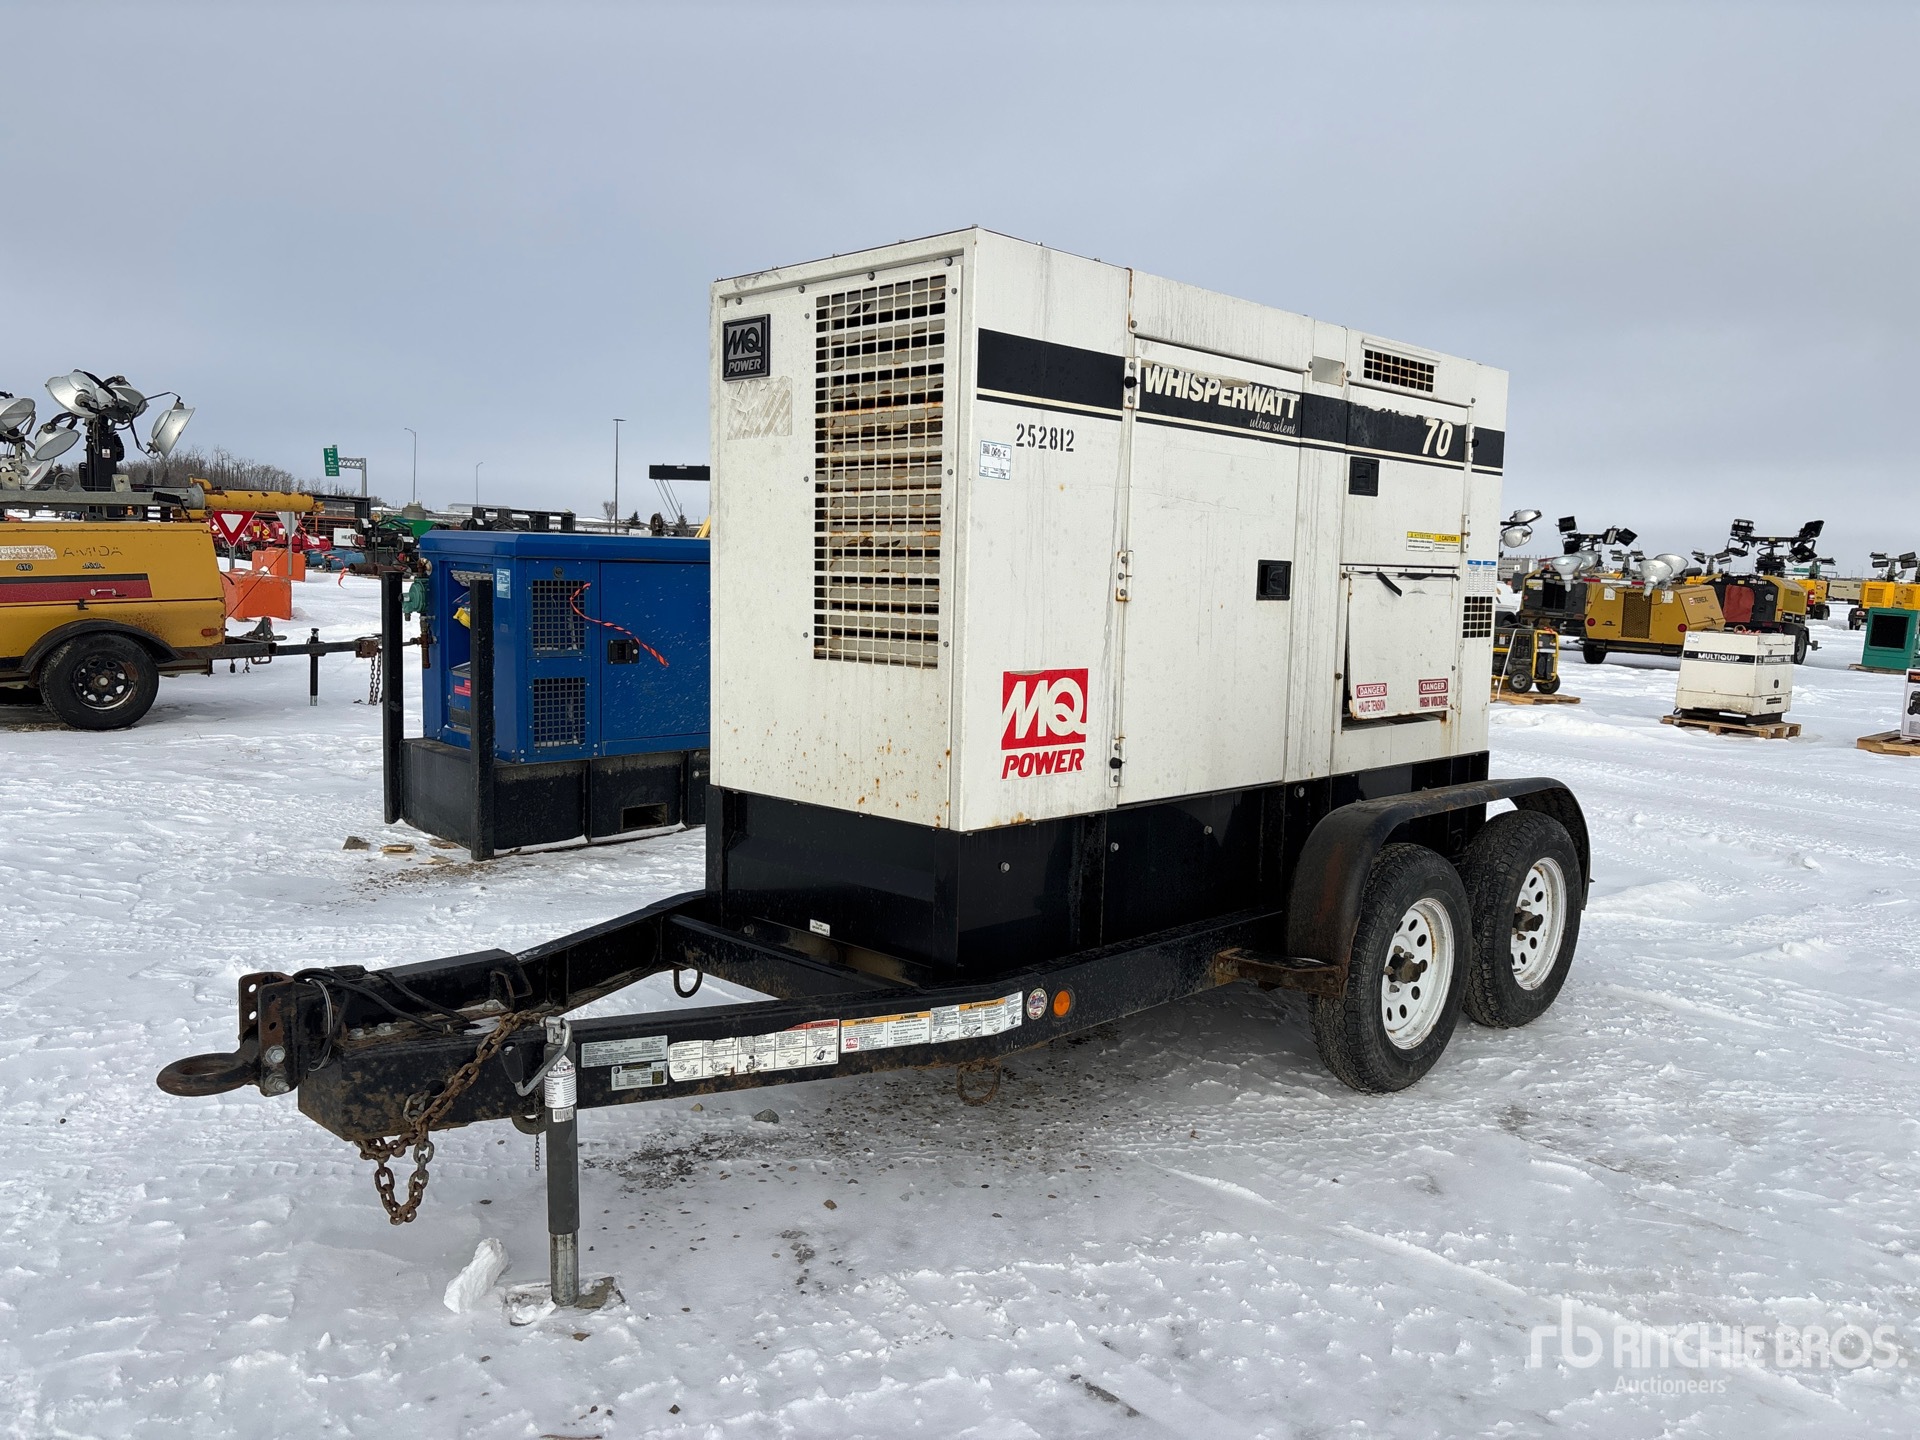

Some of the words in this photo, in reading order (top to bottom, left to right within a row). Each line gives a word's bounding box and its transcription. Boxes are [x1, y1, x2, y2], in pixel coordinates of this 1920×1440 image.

[727, 326, 762, 356] MQ
[728, 359, 762, 374] POWER
[1145, 364, 1300, 419] WHISPERWATT
[1249, 412, 1272, 430] ultra
[1272, 417, 1297, 435] silent
[1016, 423, 1075, 452] 252812
[1422, 418, 1453, 457] 70
[16, 562, 33, 571] 410
[1698, 652, 1740, 661] MULTIQUIP
[1360, 684, 1384, 695] DANGER
[1422, 682, 1445, 691] DANGER
[1001, 678, 1086, 739] MQ
[1420, 696, 1430, 708] HIGH
[1431, 695, 1448, 706] VOLTAGE
[1002, 748, 1084, 779] POWER
